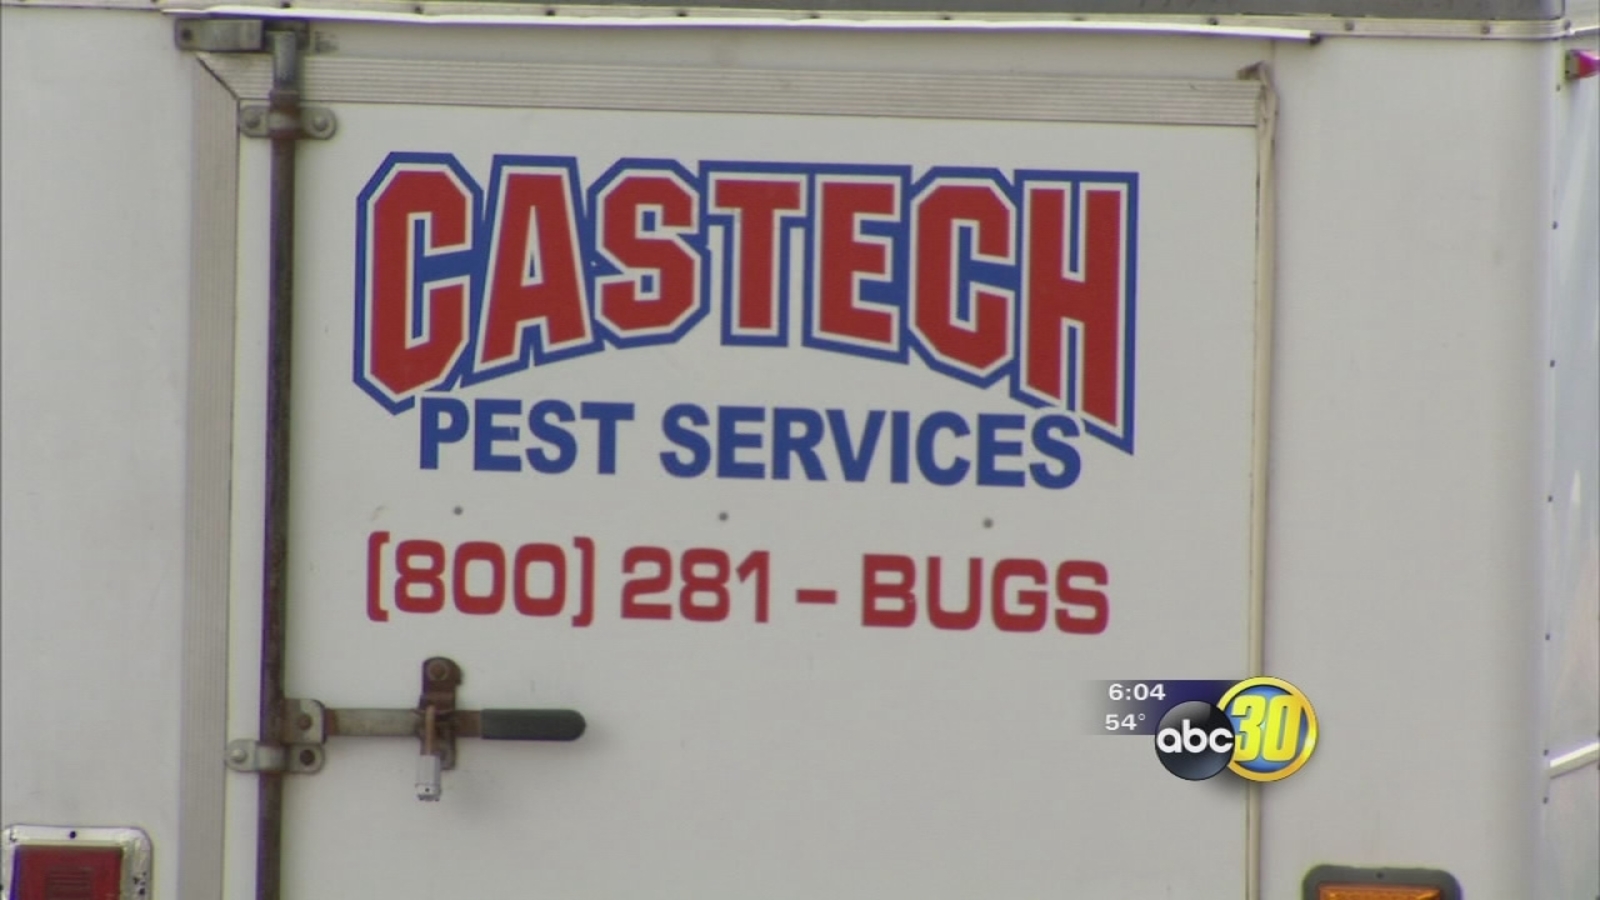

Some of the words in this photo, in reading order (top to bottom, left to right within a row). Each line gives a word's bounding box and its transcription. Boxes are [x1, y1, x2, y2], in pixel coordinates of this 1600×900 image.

[354, 152, 1139, 454] CASTECH
[421, 397, 636, 474] PEST
[661, 403, 1082, 489] SERVICES
[862, 554, 1109, 635] BUGS
